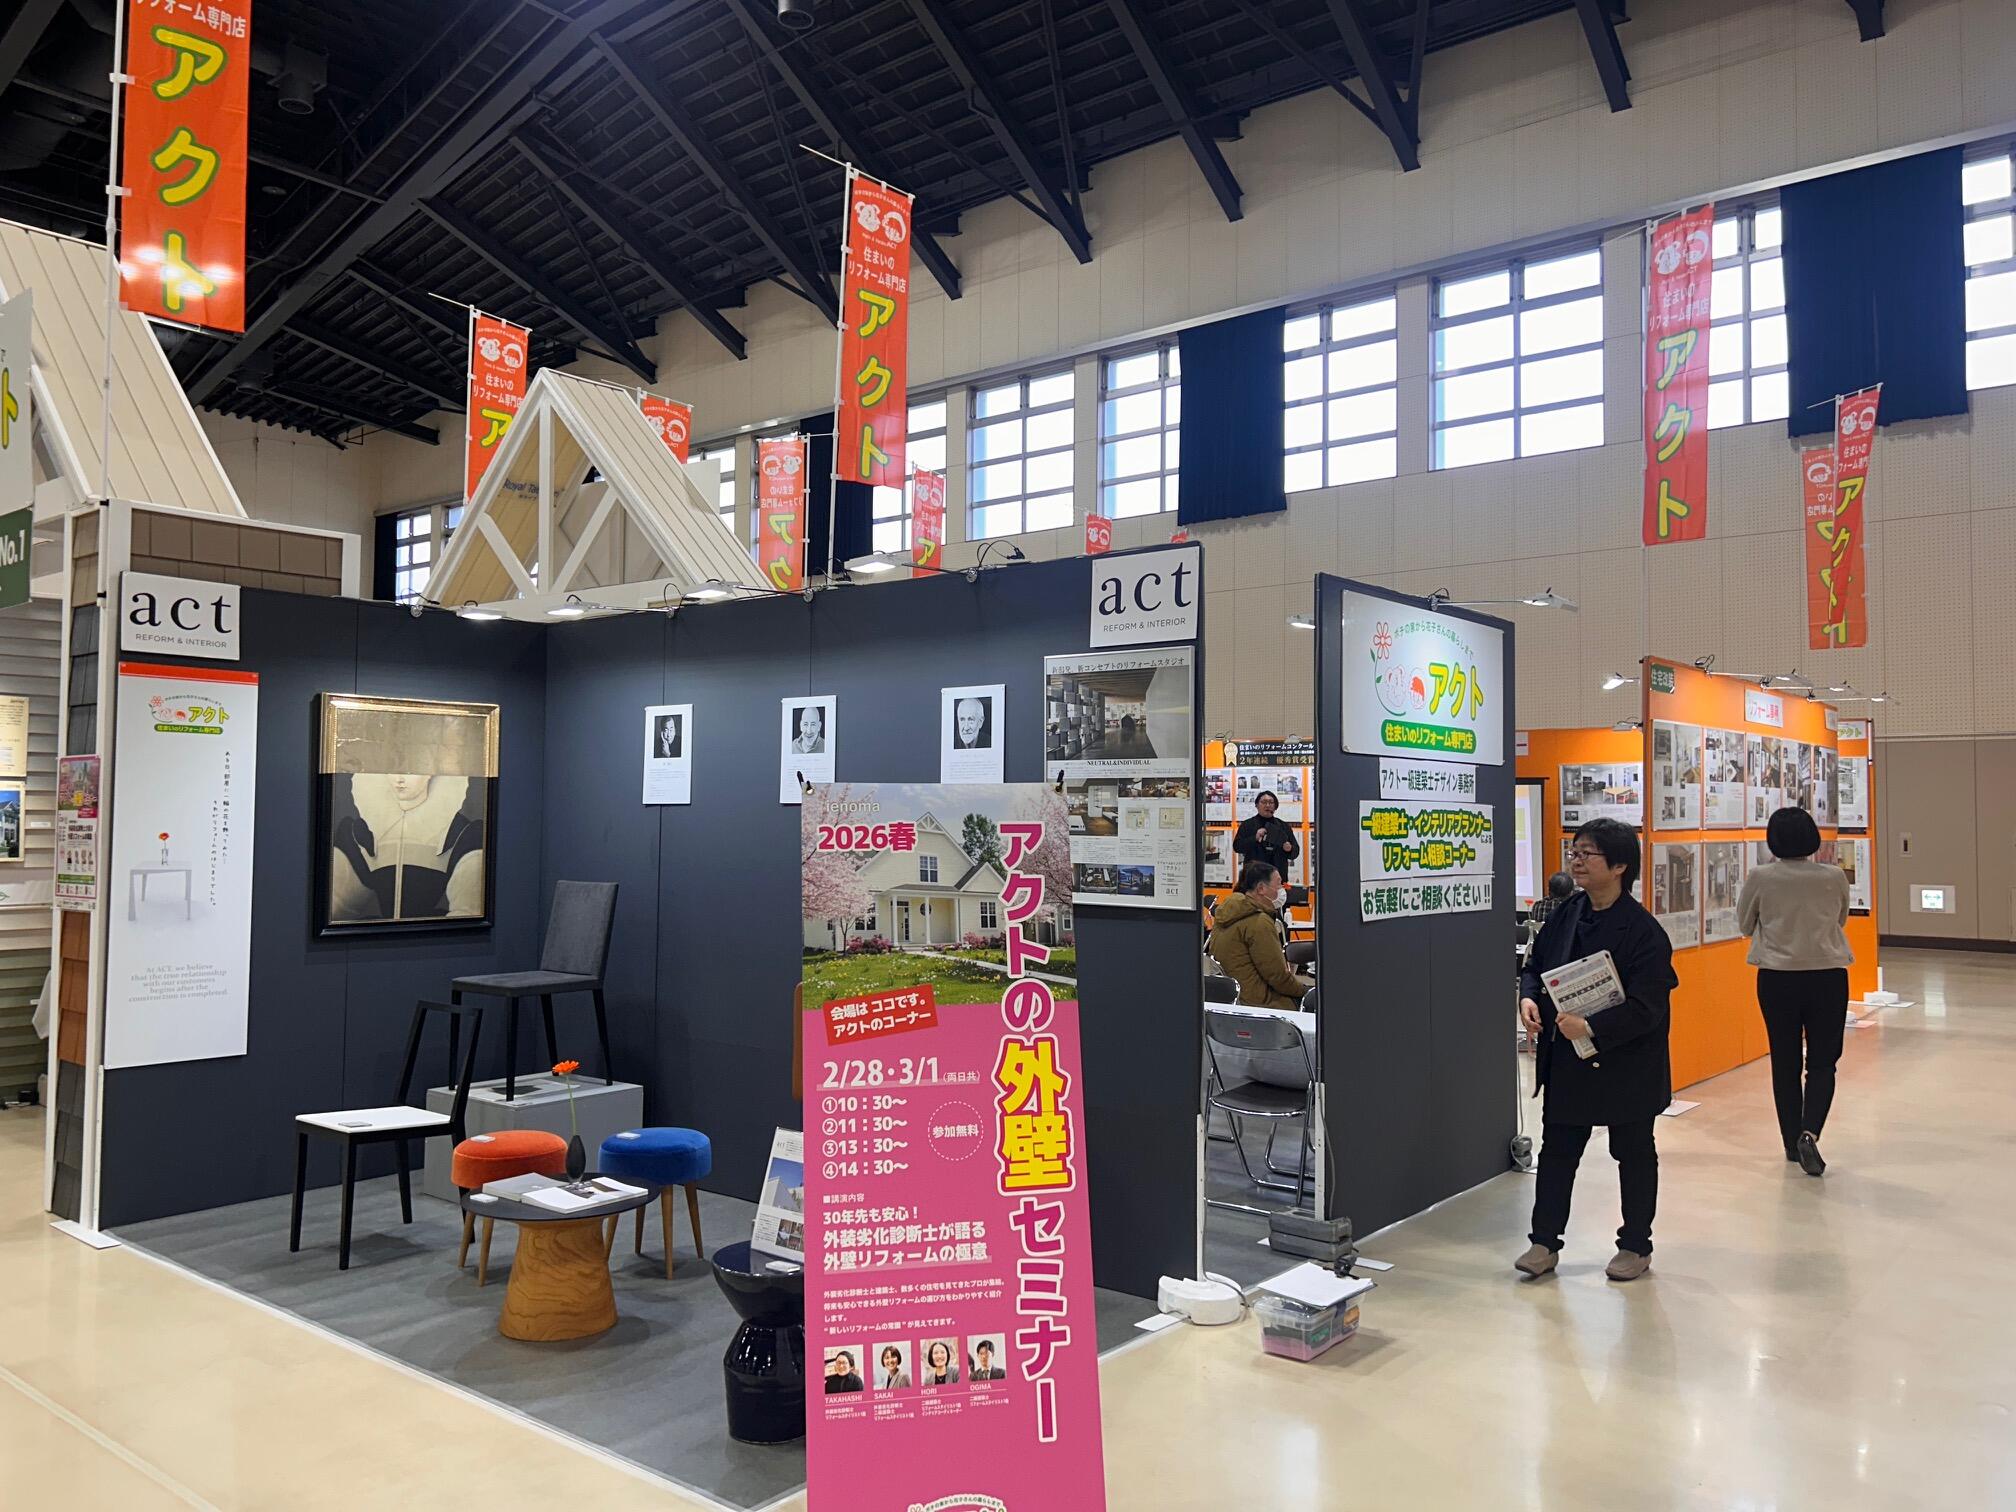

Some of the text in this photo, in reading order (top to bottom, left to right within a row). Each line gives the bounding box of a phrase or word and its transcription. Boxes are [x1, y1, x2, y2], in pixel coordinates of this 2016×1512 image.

[136, 0, 246, 38] ォーム専門店
[151, 24, 228, 314] アクト
[864, 246, 895, 270] 住まいの
[848, 260, 906, 292] リフォーム専門店
[486, 374, 514, 391] 住まいの
[857, 289, 896, 478] アクト
[1656, 328, 1698, 537] アクト
[1099, 562, 1192, 616] act
[130, 592, 232, 634] act
[1104, 622, 1137, 632] REFORM
[1146, 618, 1186, 628] INTERIOR
[136, 633, 175, 643] REFORM
[186, 638, 228, 648] INTERIOR
[1428, 662, 1484, 721] アクト
[188, 706, 230, 724] アクト
[1385, 722, 1474, 750] 住まいのリフォーム専門店
[826, 800, 880, 812] ienoma
[818, 821, 917, 852] 2026春
[1382, 840, 1476, 872] リフォーム相談コーナー
[830, 992, 926, 1021] 会場は ココです。
[834, 1012, 932, 1038] アクトのコーナー
[932, 1124, 980, 1139] 参加無料
[823, 1206, 918, 1225] 30年先も安心！
[824, 1221, 986, 1250] 外装劣化診断士が語る
[824, 1242, 988, 1272] 外壁リフォームの極意
[824, 1314, 848, 1323] します。
[825, 1394, 862, 1404] TAKAHASHI
[874, 1392, 894, 1400] SAKAI
[970, 1383, 992, 1391] OGIMA
